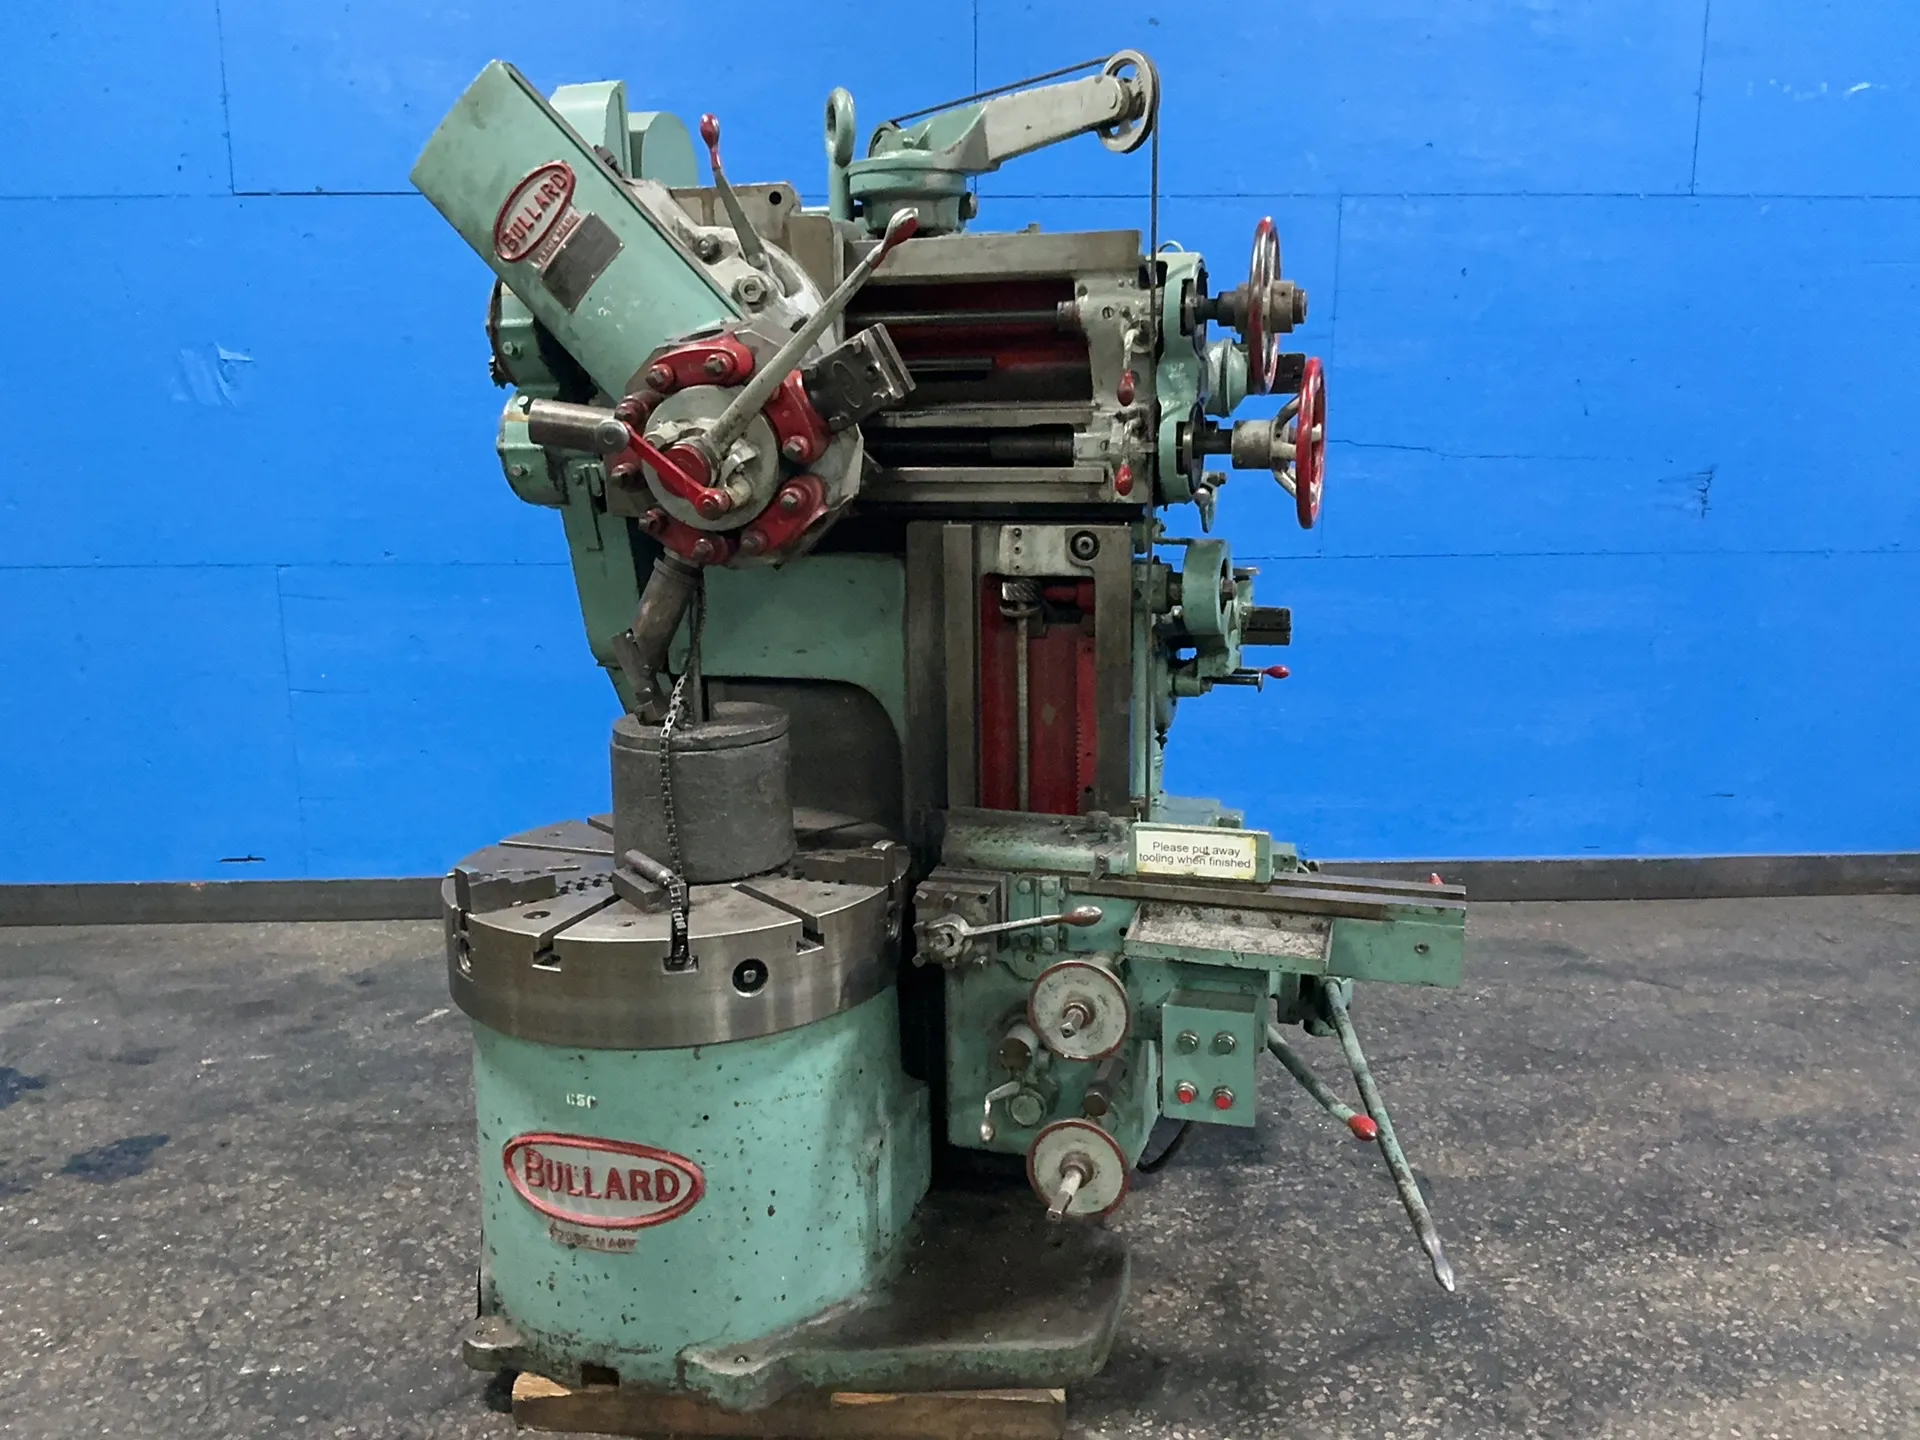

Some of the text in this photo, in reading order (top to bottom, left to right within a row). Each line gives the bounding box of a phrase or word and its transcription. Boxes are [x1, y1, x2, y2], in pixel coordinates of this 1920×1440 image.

[500, 173, 568, 252] BULLARD
[1139, 853, 1251, 868] tooling when finished
[1152, 841, 1241, 858] Please put away
[524, 1148, 680, 1203] BULLARD
